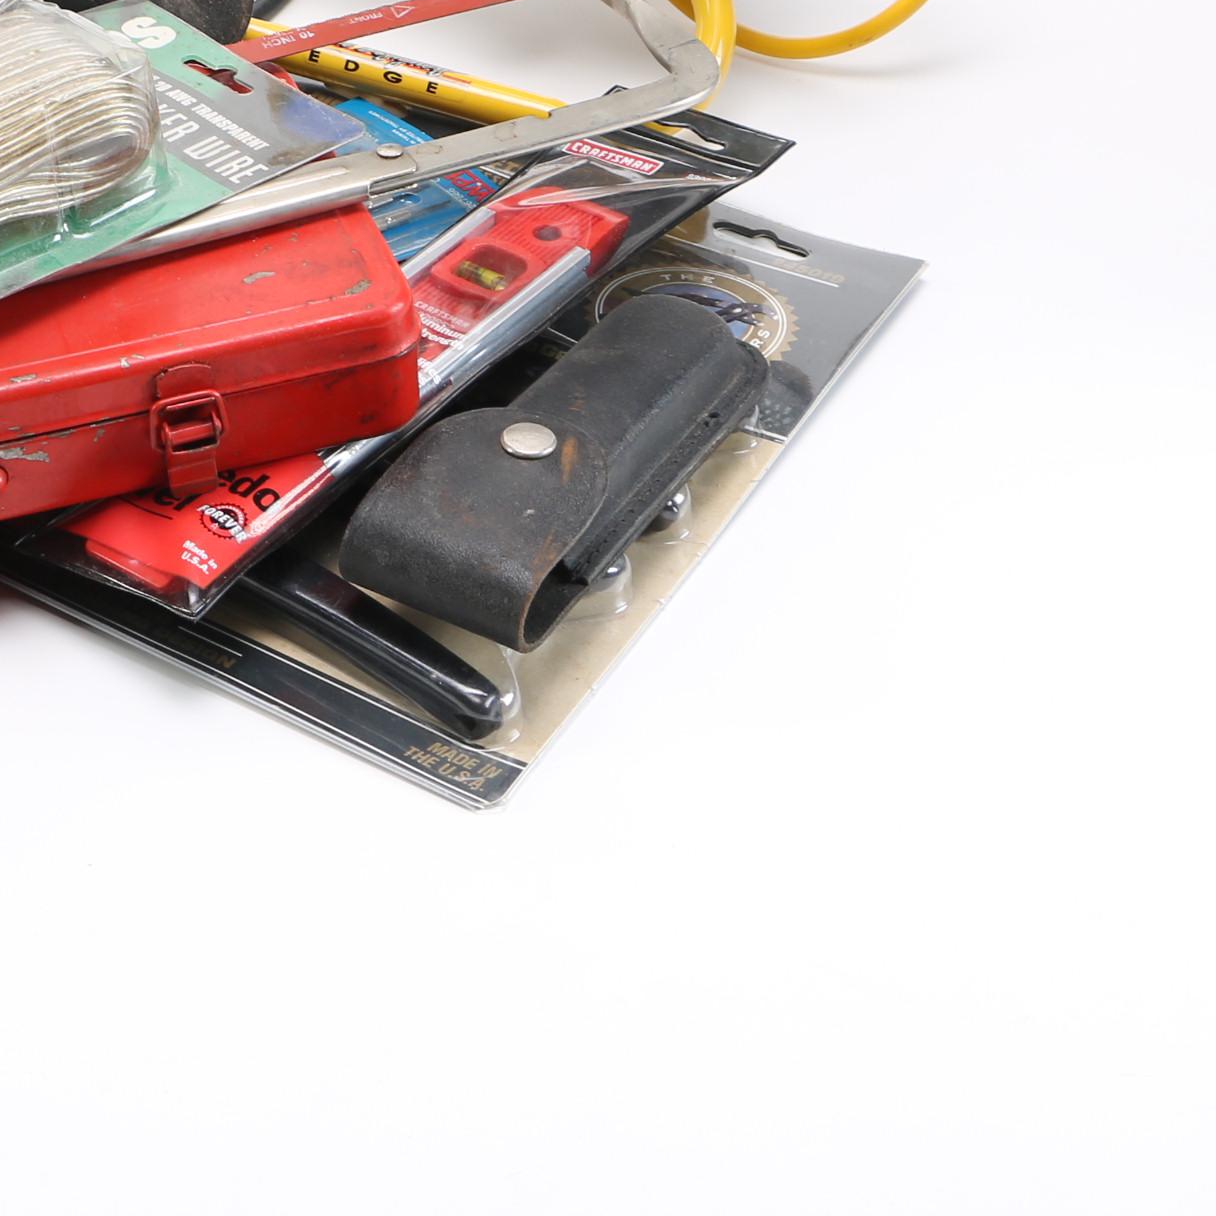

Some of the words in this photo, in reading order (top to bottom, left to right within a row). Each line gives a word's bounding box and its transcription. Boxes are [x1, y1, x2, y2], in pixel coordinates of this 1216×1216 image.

[263, 34, 296, 49] INCH
[191, 104, 271, 151] TRANSPARENT
[183, 135, 270, 184] WIRE
[571, 141, 655, 172] CRAFTSMAN
[660, 273, 715, 285] THE
[415, 300, 471, 329] CRAFTSMAN
[422, 328, 464, 351] trength
[196, 503, 249, 544] FOREVER
[181, 552, 209, 575] U.S.A.
[183, 539, 209, 561] Made
[208, 557, 218, 570] in
[404, 745, 439, 770] THE
[439, 762, 485, 792] U.S.A.
[427, 741, 482, 771] MADE
[482, 763, 502, 779] IN
